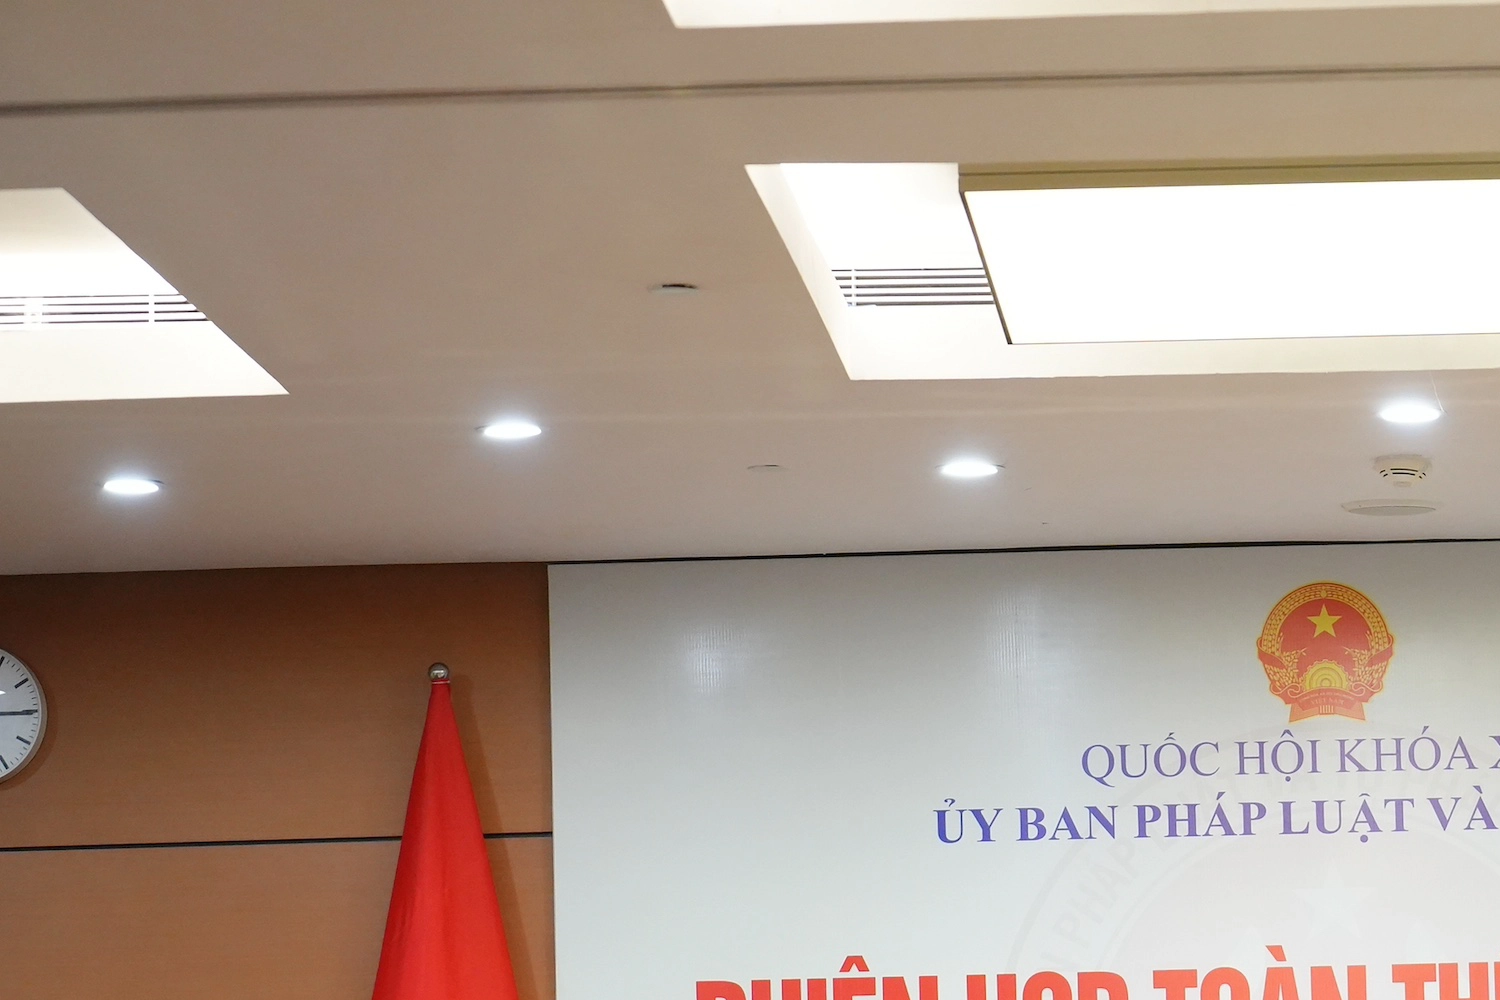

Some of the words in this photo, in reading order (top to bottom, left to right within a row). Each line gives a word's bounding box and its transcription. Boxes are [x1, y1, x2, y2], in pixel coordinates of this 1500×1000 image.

[1081, 731, 1220, 788] QUỐC
[1233, 728, 1322, 783] HỘI
[1335, 725, 1479, 773] KHÓA
[933, 797, 1004, 845] ỦY
[1015, 804, 1119, 843] BAN
[1133, 791, 1267, 839] PHÁP
[1278, 792, 1415, 844] LUẬT
[1426, 784, 1500, 832] VÀ
